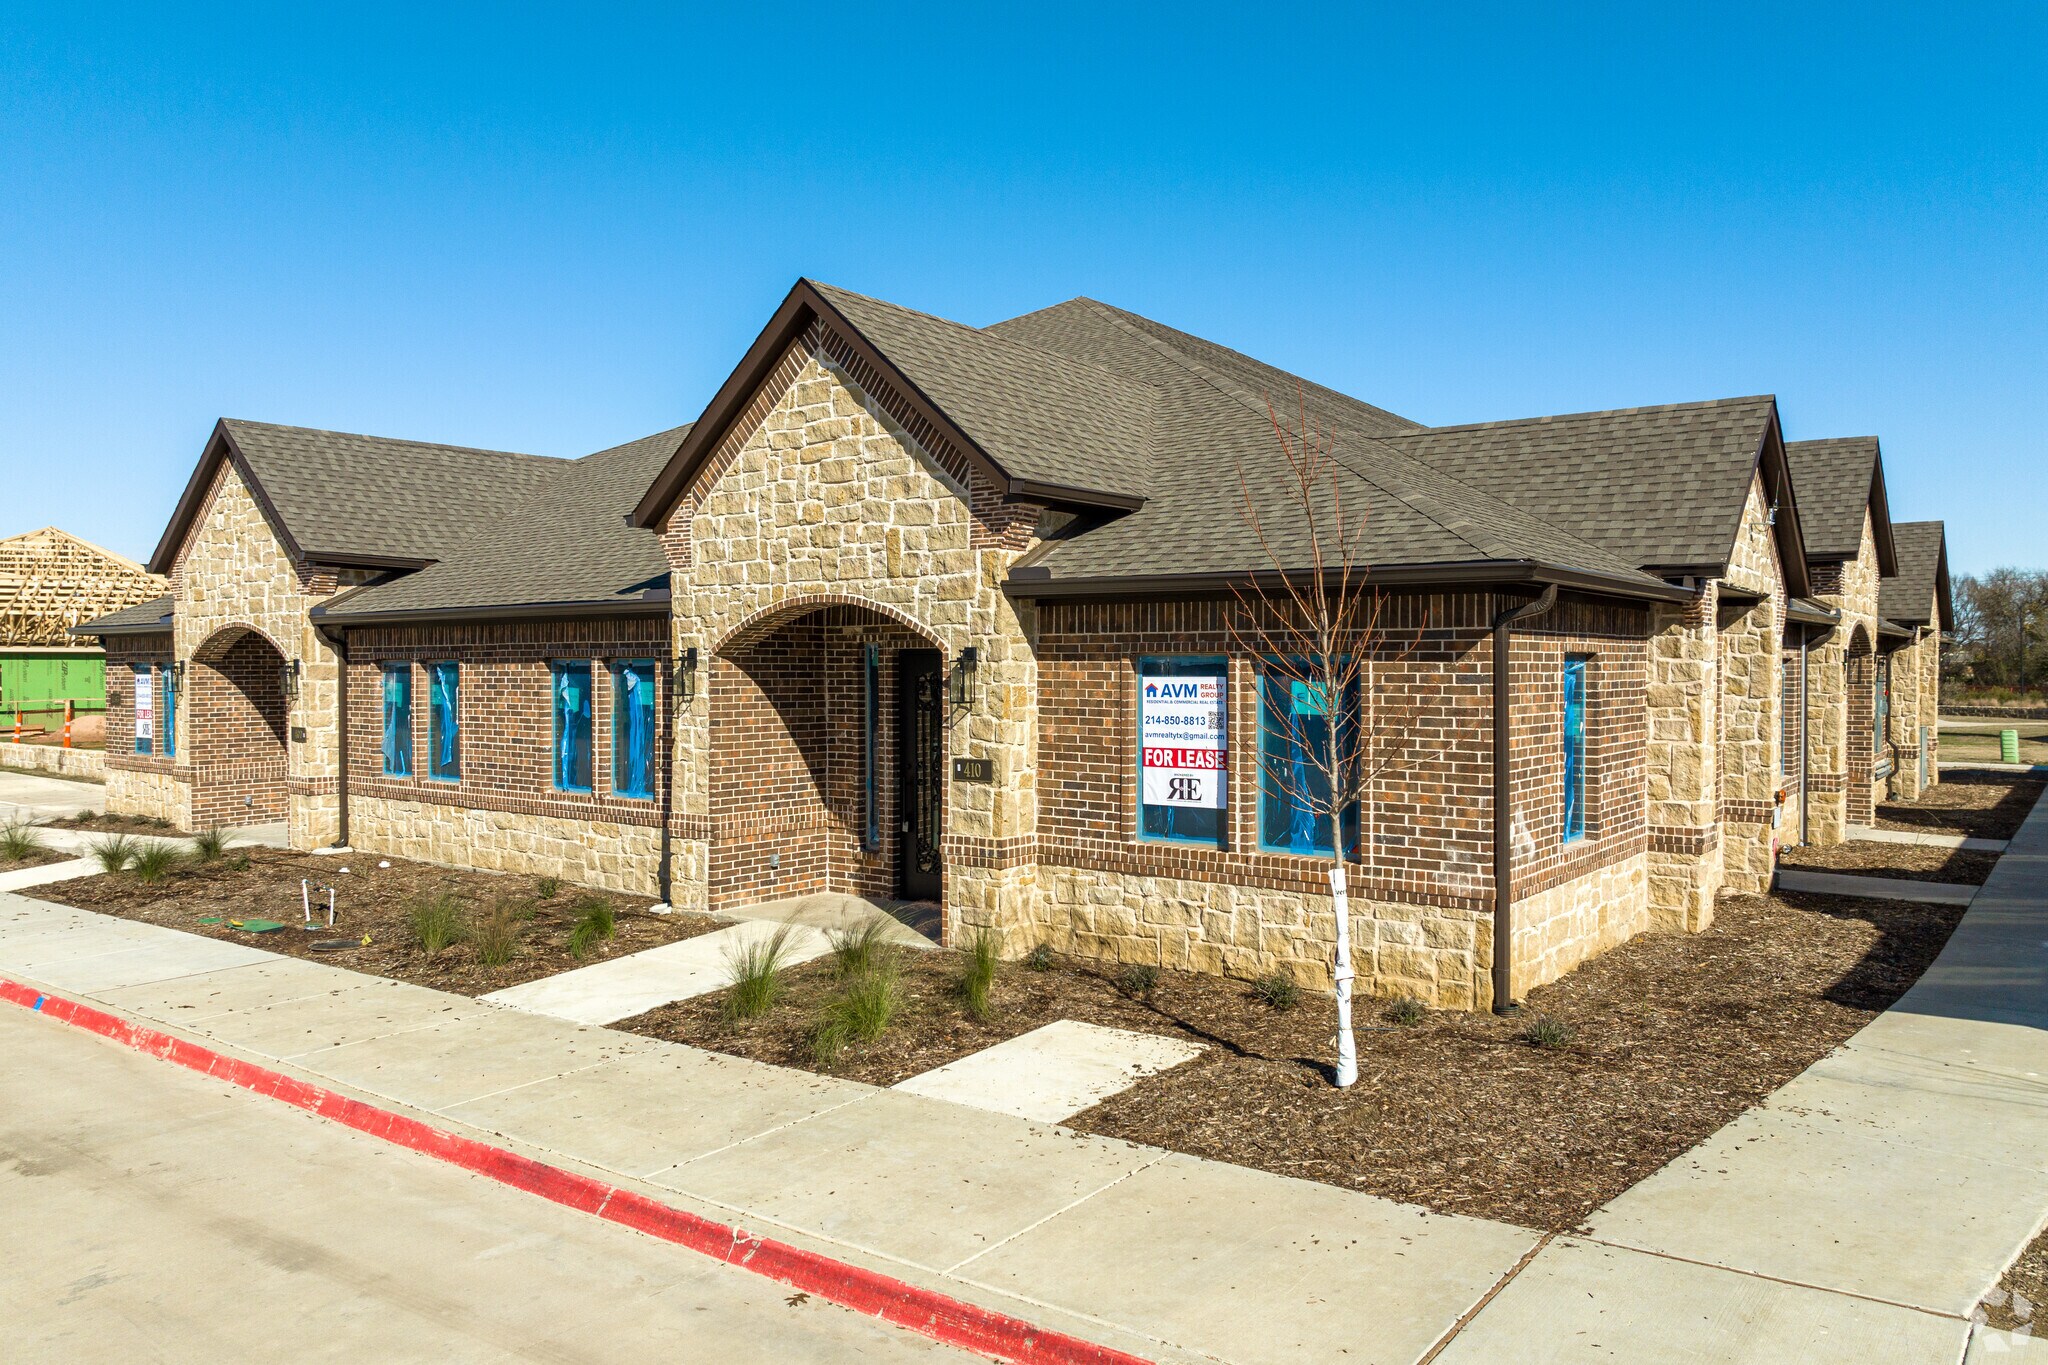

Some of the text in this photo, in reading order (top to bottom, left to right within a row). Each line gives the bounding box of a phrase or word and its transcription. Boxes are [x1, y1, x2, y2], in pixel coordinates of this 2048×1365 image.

[1161, 684, 1197, 698] AVM
[1145, 716, 1206, 725] 214-850-8813
[1145, 732, 1225, 740] avmrealtytx@gmail.com
[1145, 749, 1224, 769] FOR LEASE
[963, 762, 982, 777] 410
